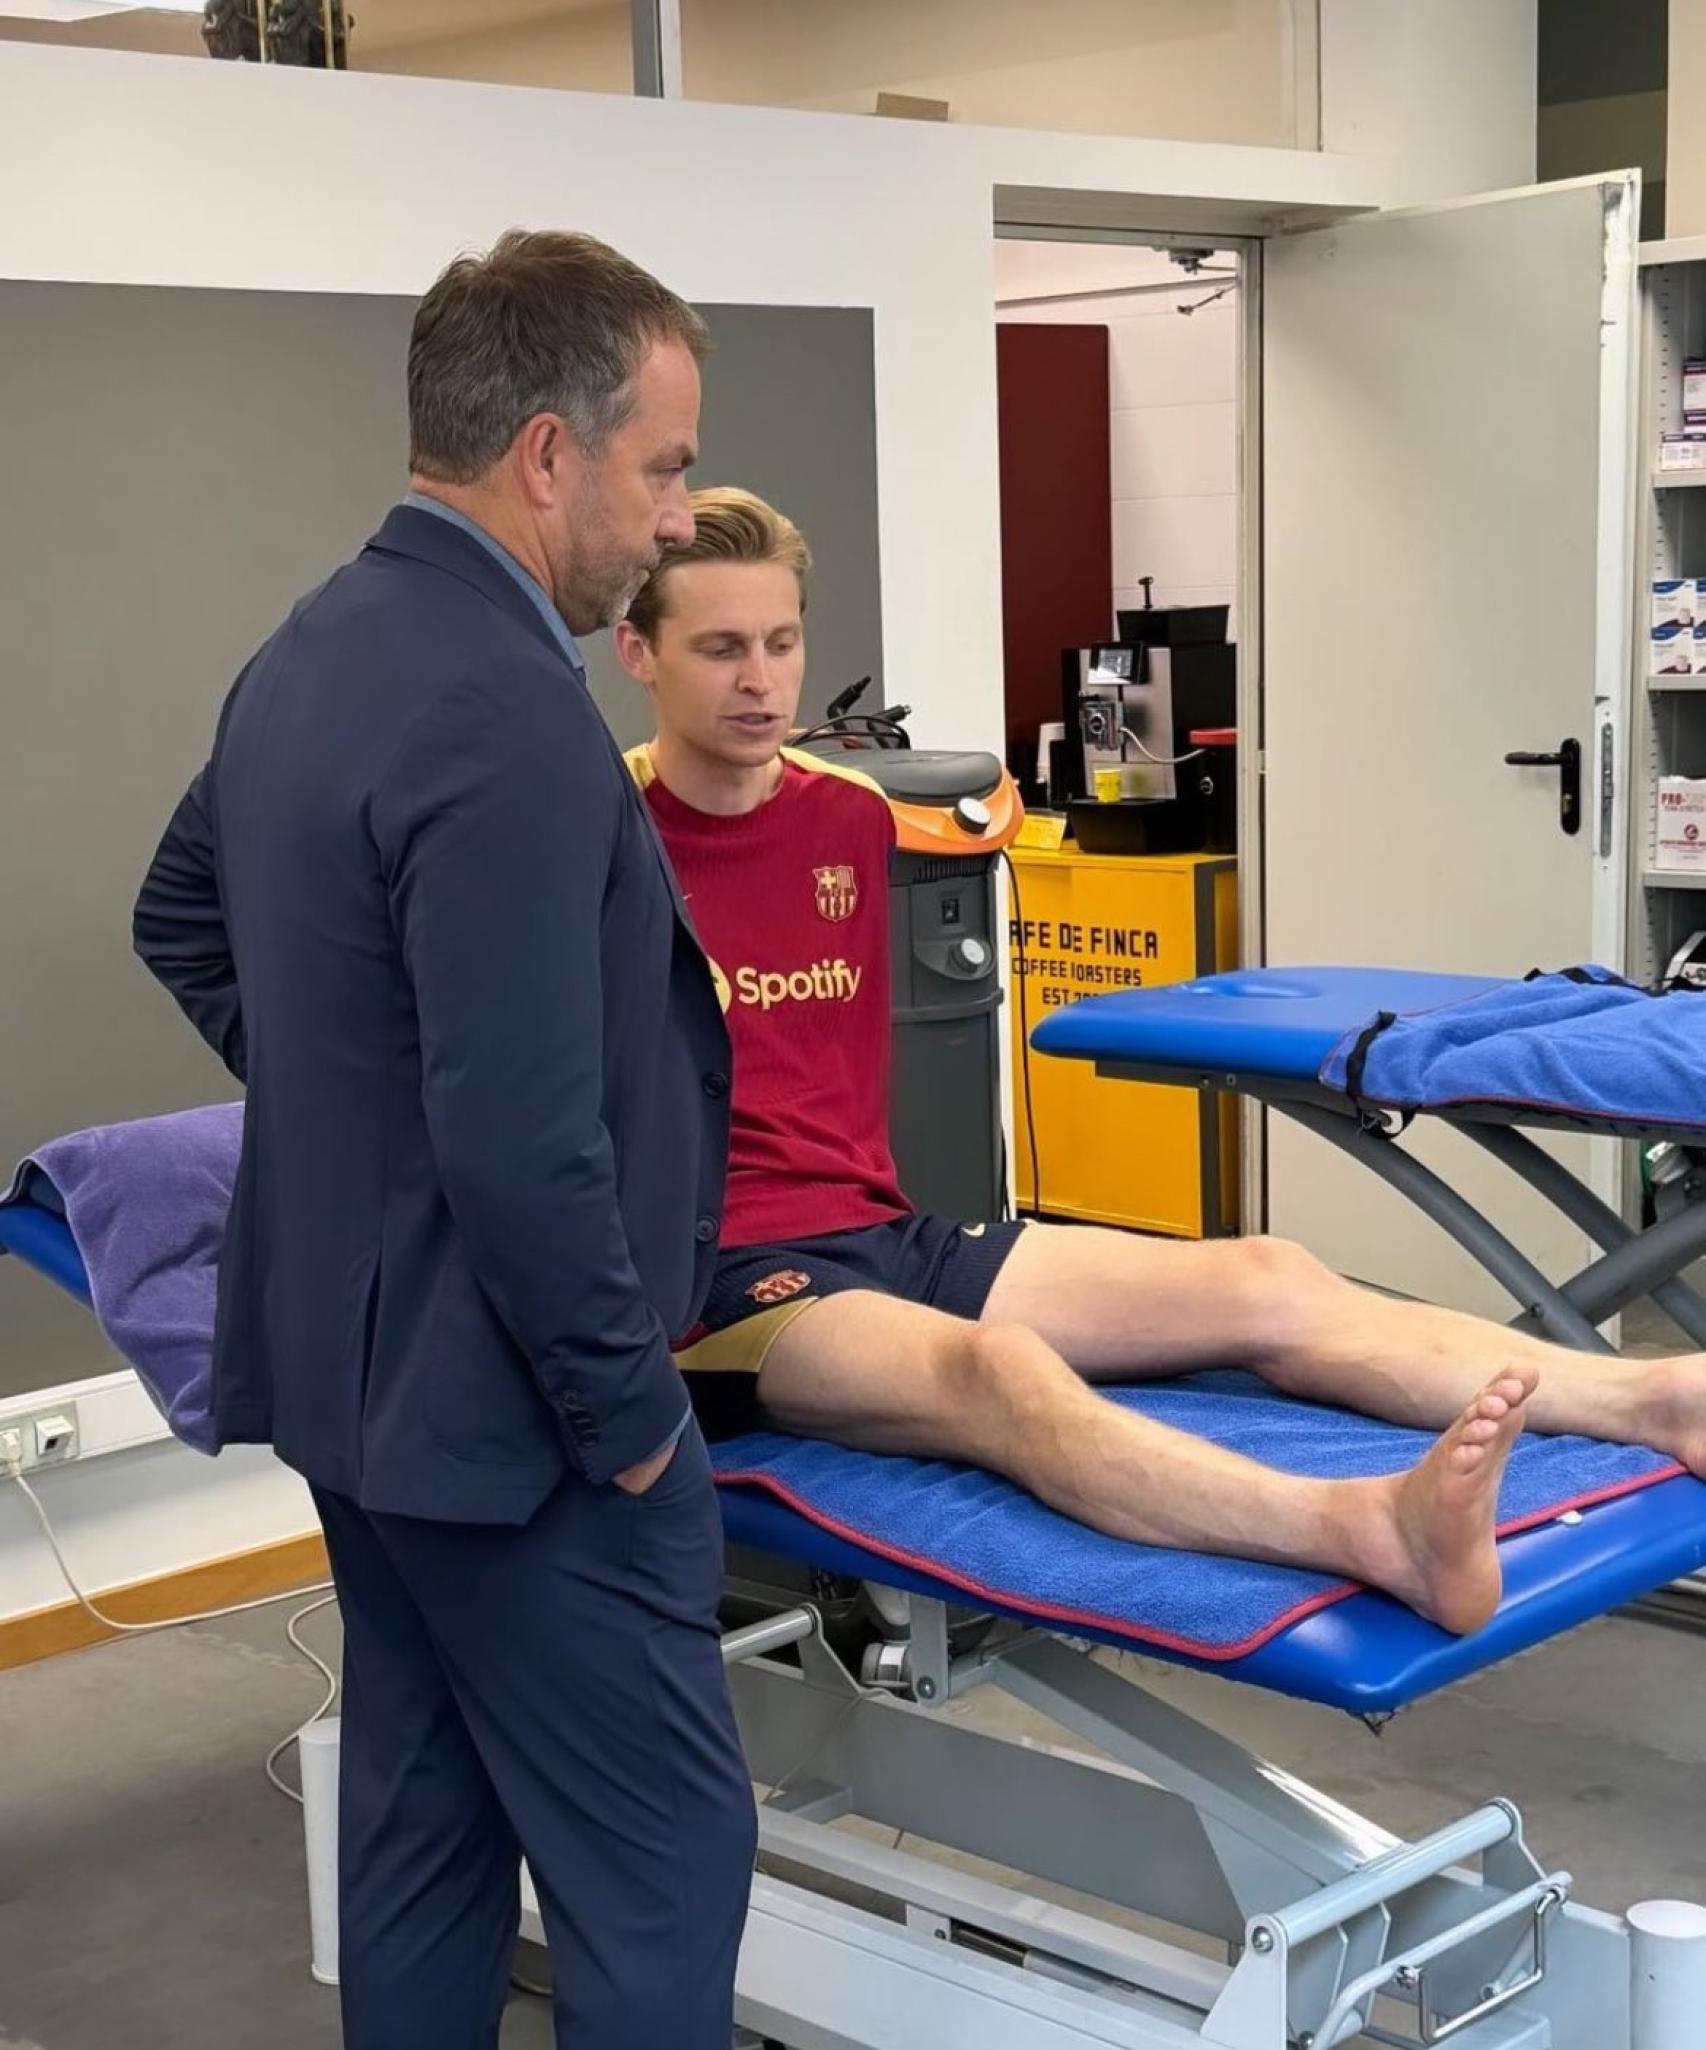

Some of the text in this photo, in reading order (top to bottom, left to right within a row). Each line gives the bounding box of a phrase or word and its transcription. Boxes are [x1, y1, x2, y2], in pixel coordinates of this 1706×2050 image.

[1009, 920, 1158, 959] AFE DE FINCA
[736, 959, 861, 1010] Spotify
[1011, 958, 1066, 978] COFFEE
